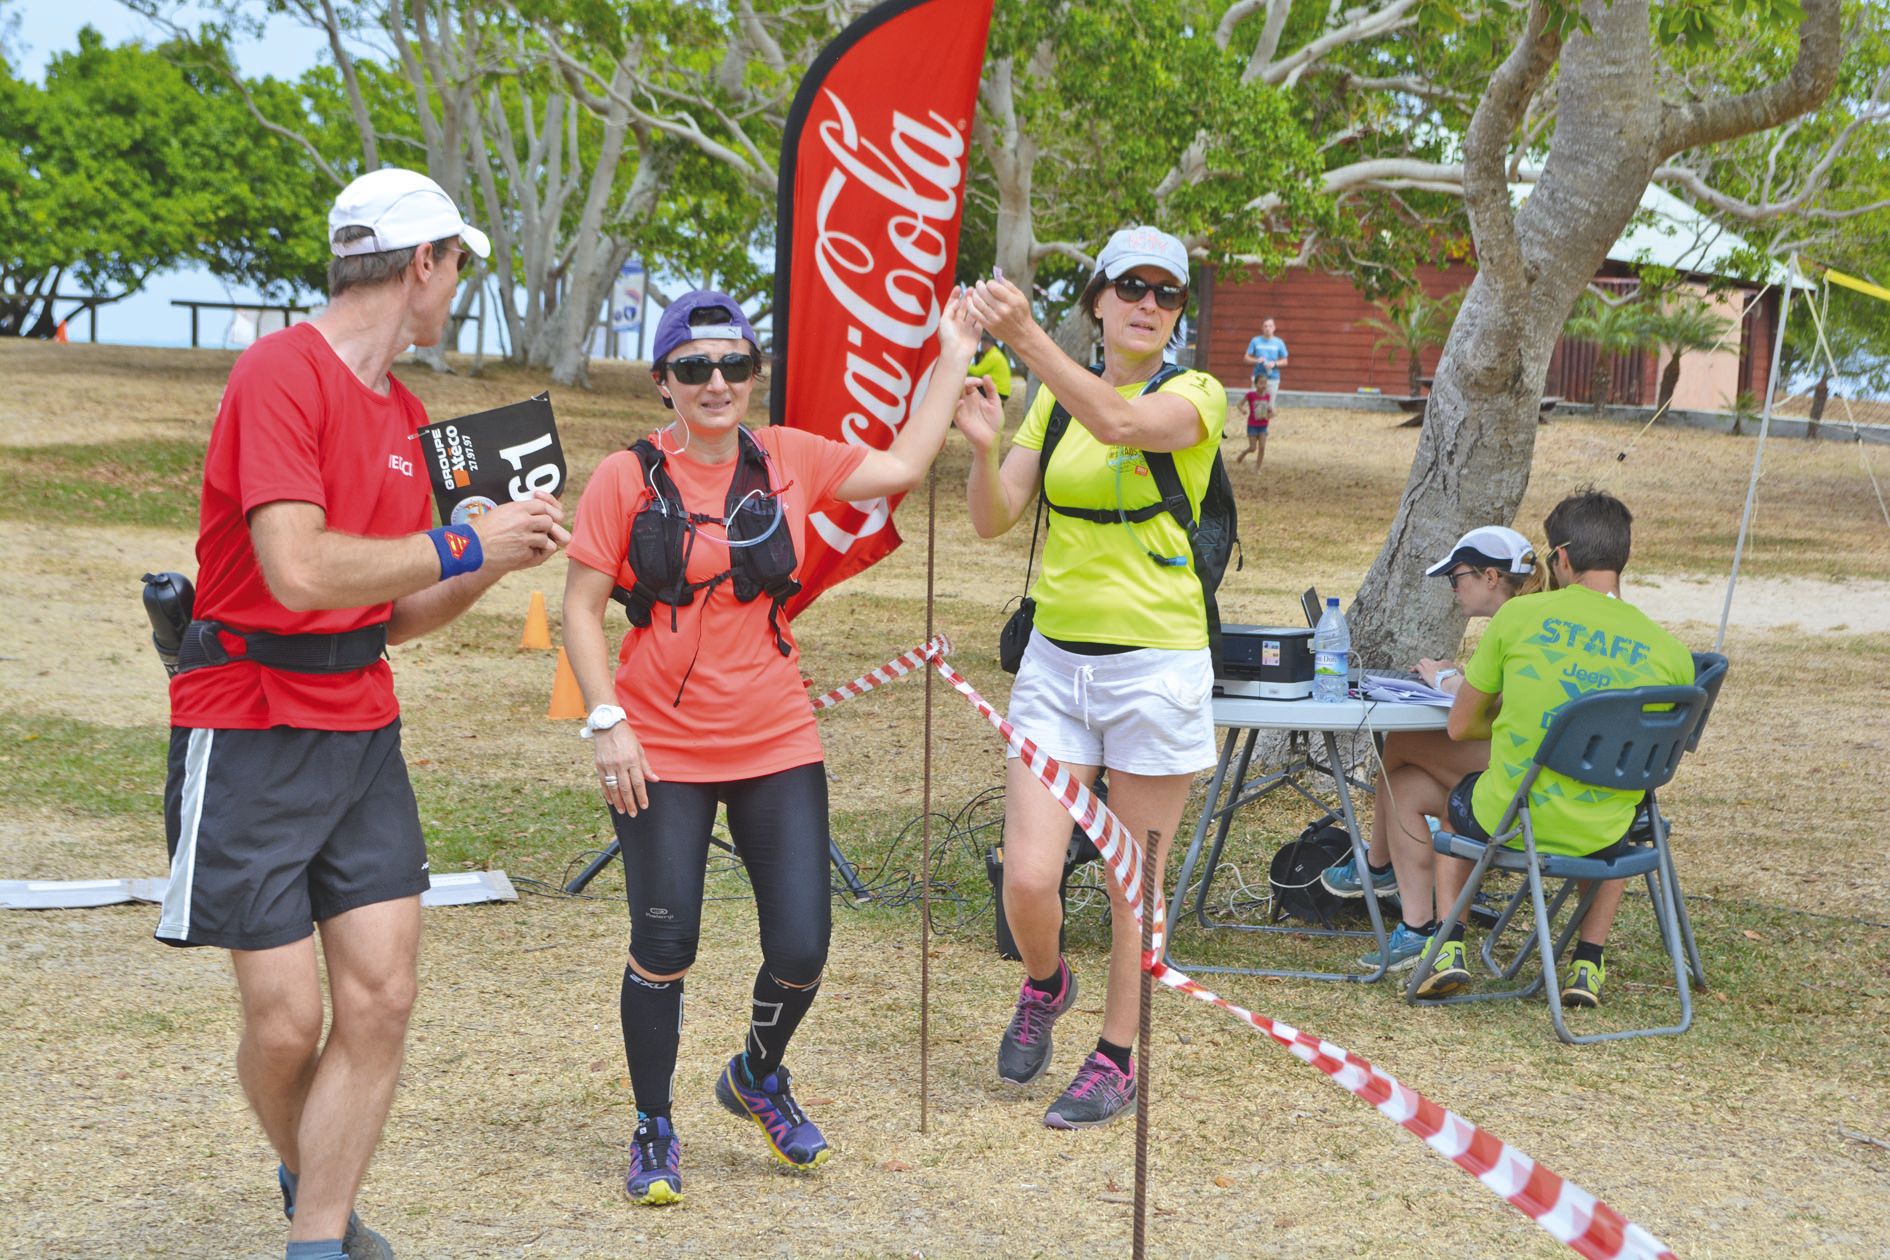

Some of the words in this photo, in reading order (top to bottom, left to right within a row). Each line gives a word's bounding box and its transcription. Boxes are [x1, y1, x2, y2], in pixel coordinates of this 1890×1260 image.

[809, 87, 965, 555] ca-Cola
[431, 428, 455, 490] GROUPE
[461, 435, 479, 471] 27.97.97
[1539, 618, 1650, 665] STAFF
[1563, 663, 1611, 688] Jeep
